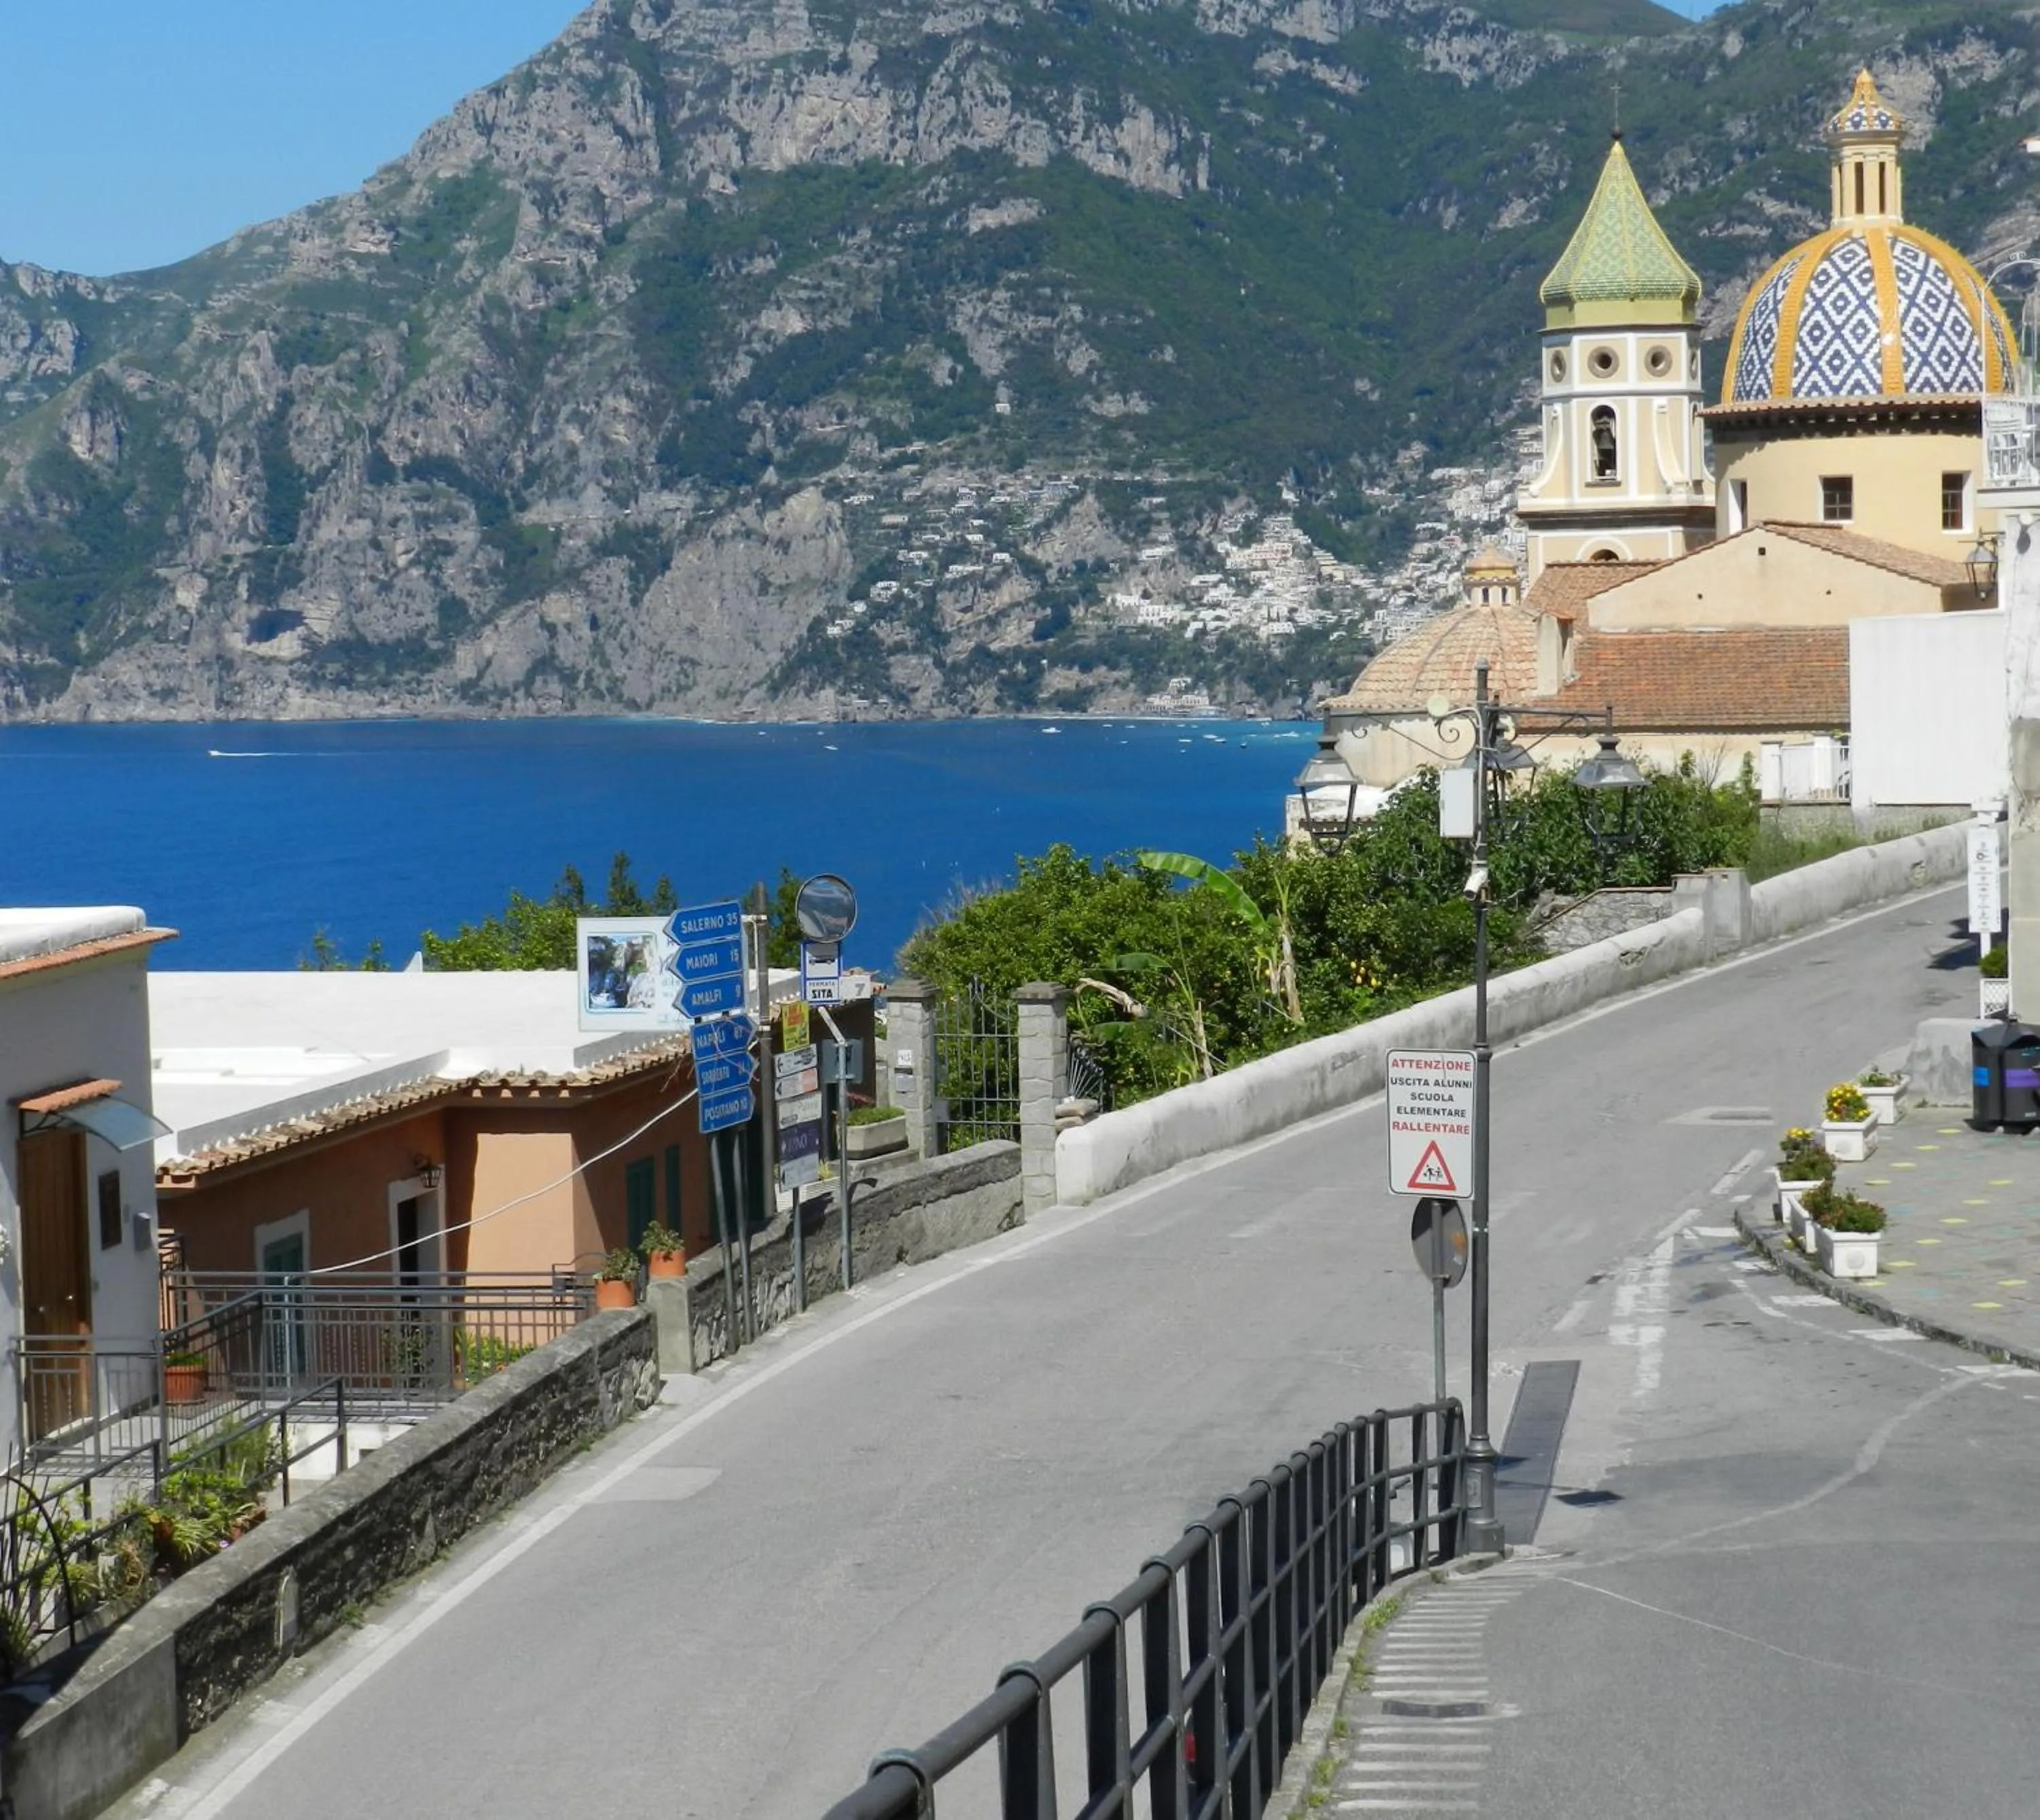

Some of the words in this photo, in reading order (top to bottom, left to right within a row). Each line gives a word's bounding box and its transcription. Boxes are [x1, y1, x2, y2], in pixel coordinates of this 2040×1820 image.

[681, 915, 724, 934] SALERNO
[726, 912, 738, 925] 35
[685, 953, 718, 970] MAIORI
[730, 949, 739, 962] 15
[692, 989, 722, 1005] AMALFI
[811, 988, 833, 999] SITA
[696, 1029, 726, 1049] NAPOLI
[1392, 1058, 1471, 1071] ATTENZIONE
[1391, 1077, 1429, 1087] USCITA
[1433, 1079, 1472, 1089] ALUNNI
[1410, 1092, 1455, 1102] SCUOLA
[704, 1098, 738, 1121] POSITANO
[1396, 1105, 1466, 1117] ELEMENTARE
[1392, 1120, 1469, 1135] RALLENTARE
